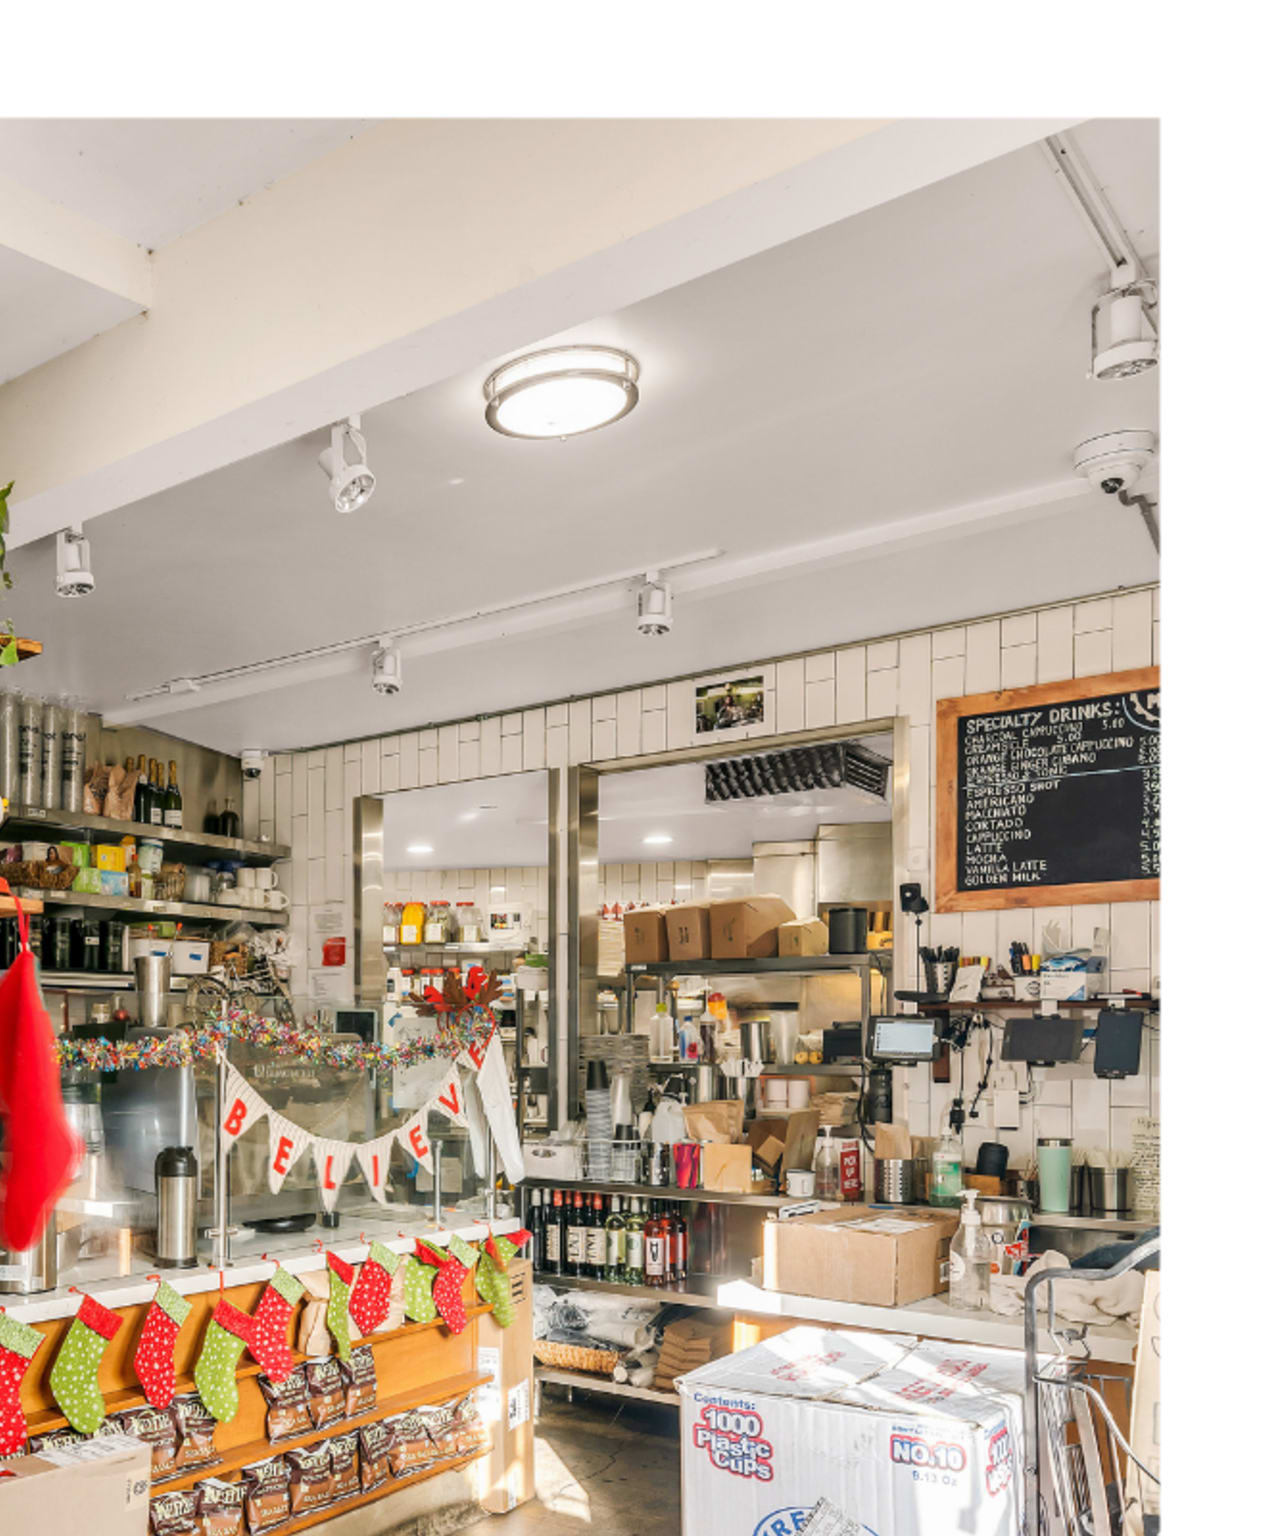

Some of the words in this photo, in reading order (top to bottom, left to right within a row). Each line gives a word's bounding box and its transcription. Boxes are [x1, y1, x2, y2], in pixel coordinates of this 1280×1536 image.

[966, 711, 1043, 734] SPECIALTY
[1048, 701, 1121, 724] DRINKS:
[965, 817, 1024, 833] CORTADO
[966, 841, 1004, 855] LATTE
[965, 853, 1007, 865] MOCHA
[964, 873, 1009, 887] GOLDEN
[1011, 872, 1042, 883] MILK
[693, 1392, 756, 1411] Contents:
[702, 1407, 762, 1438] 1000
[695, 1427, 772, 1461] Plastic
[713, 1449, 772, 1481] Cups
